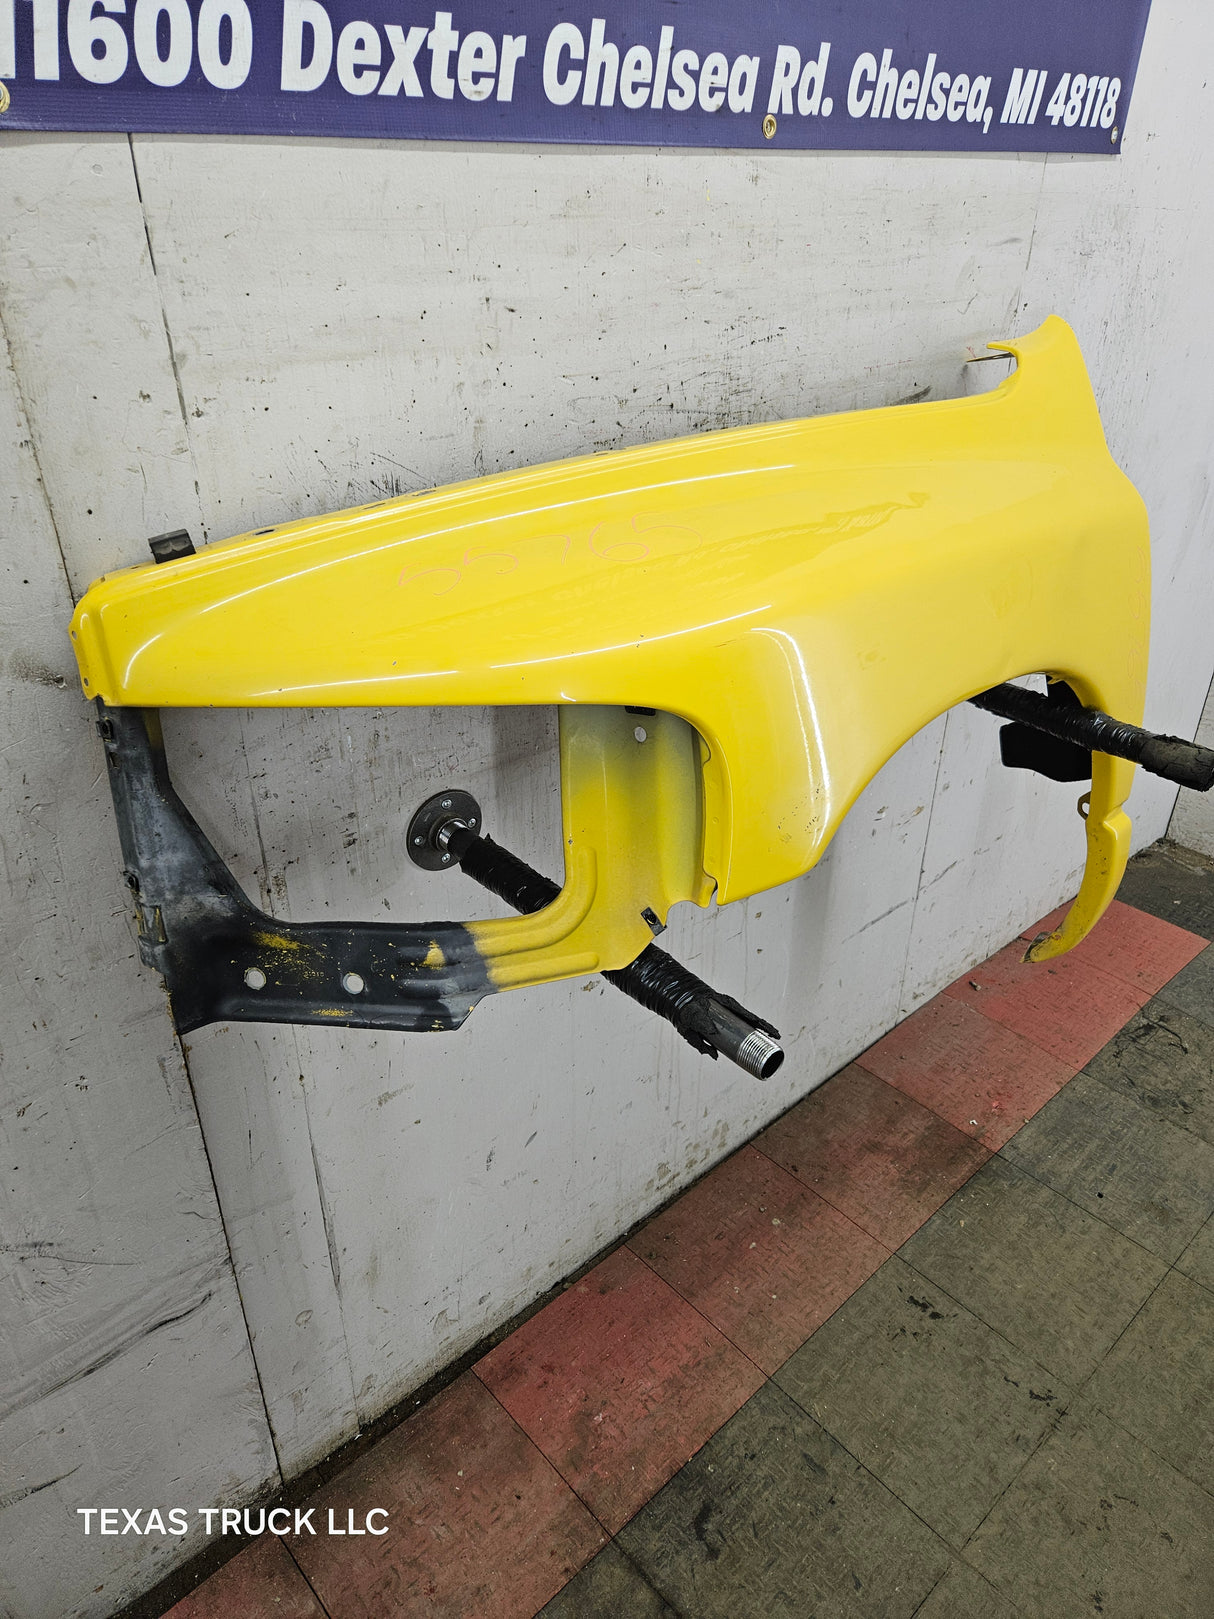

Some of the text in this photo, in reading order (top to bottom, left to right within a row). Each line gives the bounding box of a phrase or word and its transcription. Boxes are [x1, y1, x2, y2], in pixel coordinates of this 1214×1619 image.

[281, 0, 527, 101] Dexter
[543, 18, 760, 113] Chelsea
[769, 42, 833, 117] Rd.
[847, 48, 993, 133] Chelsea,
[1000, 67, 1047, 125] MI
[1046, 72, 1121, 129] 48118
